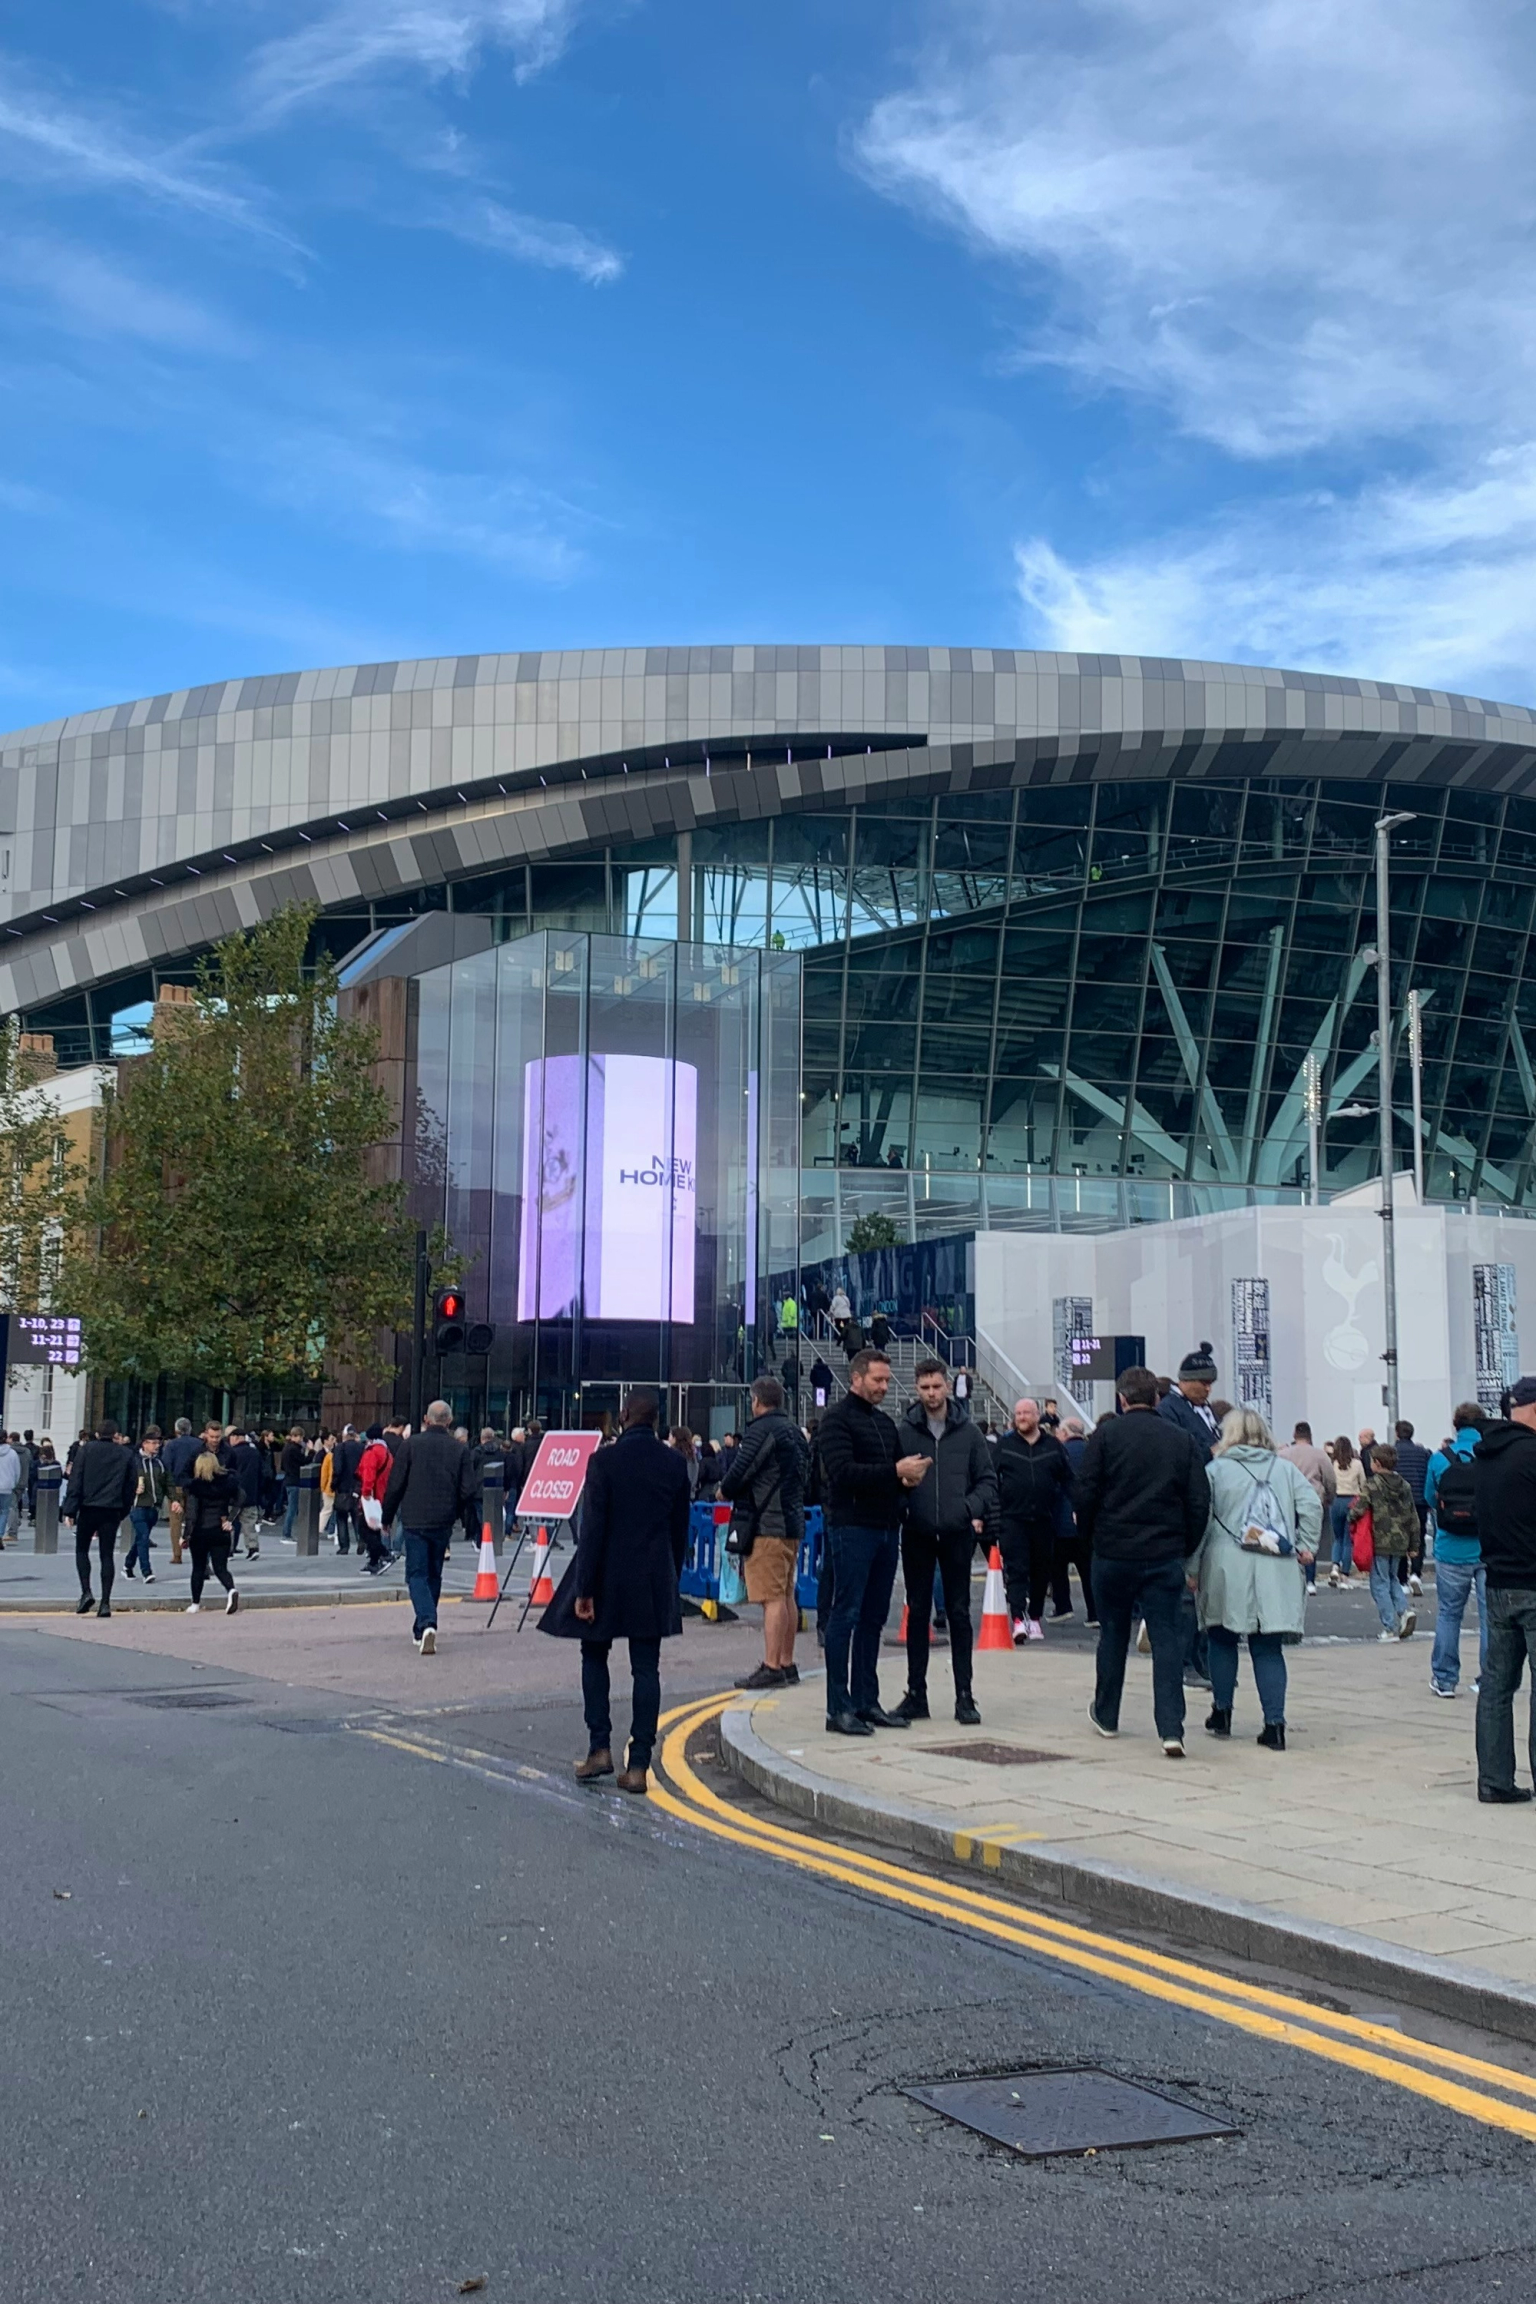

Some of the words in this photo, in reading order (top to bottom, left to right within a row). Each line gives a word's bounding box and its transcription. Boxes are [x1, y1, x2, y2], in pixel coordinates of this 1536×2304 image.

[652, 1155, 692, 1175] NEW
[620, 1169, 686, 1189] HOME
[19, 1317, 48, 1331] 1-10,
[50, 1318, 65, 1330] 23
[31, 1334, 63, 1346] 11-21
[47, 1350, 63, 1361] 22
[1081, 1353, 1092, 1365] 22
[547, 1448, 580, 1467] ROAD
[530, 1480, 574, 1499] CLOSED
